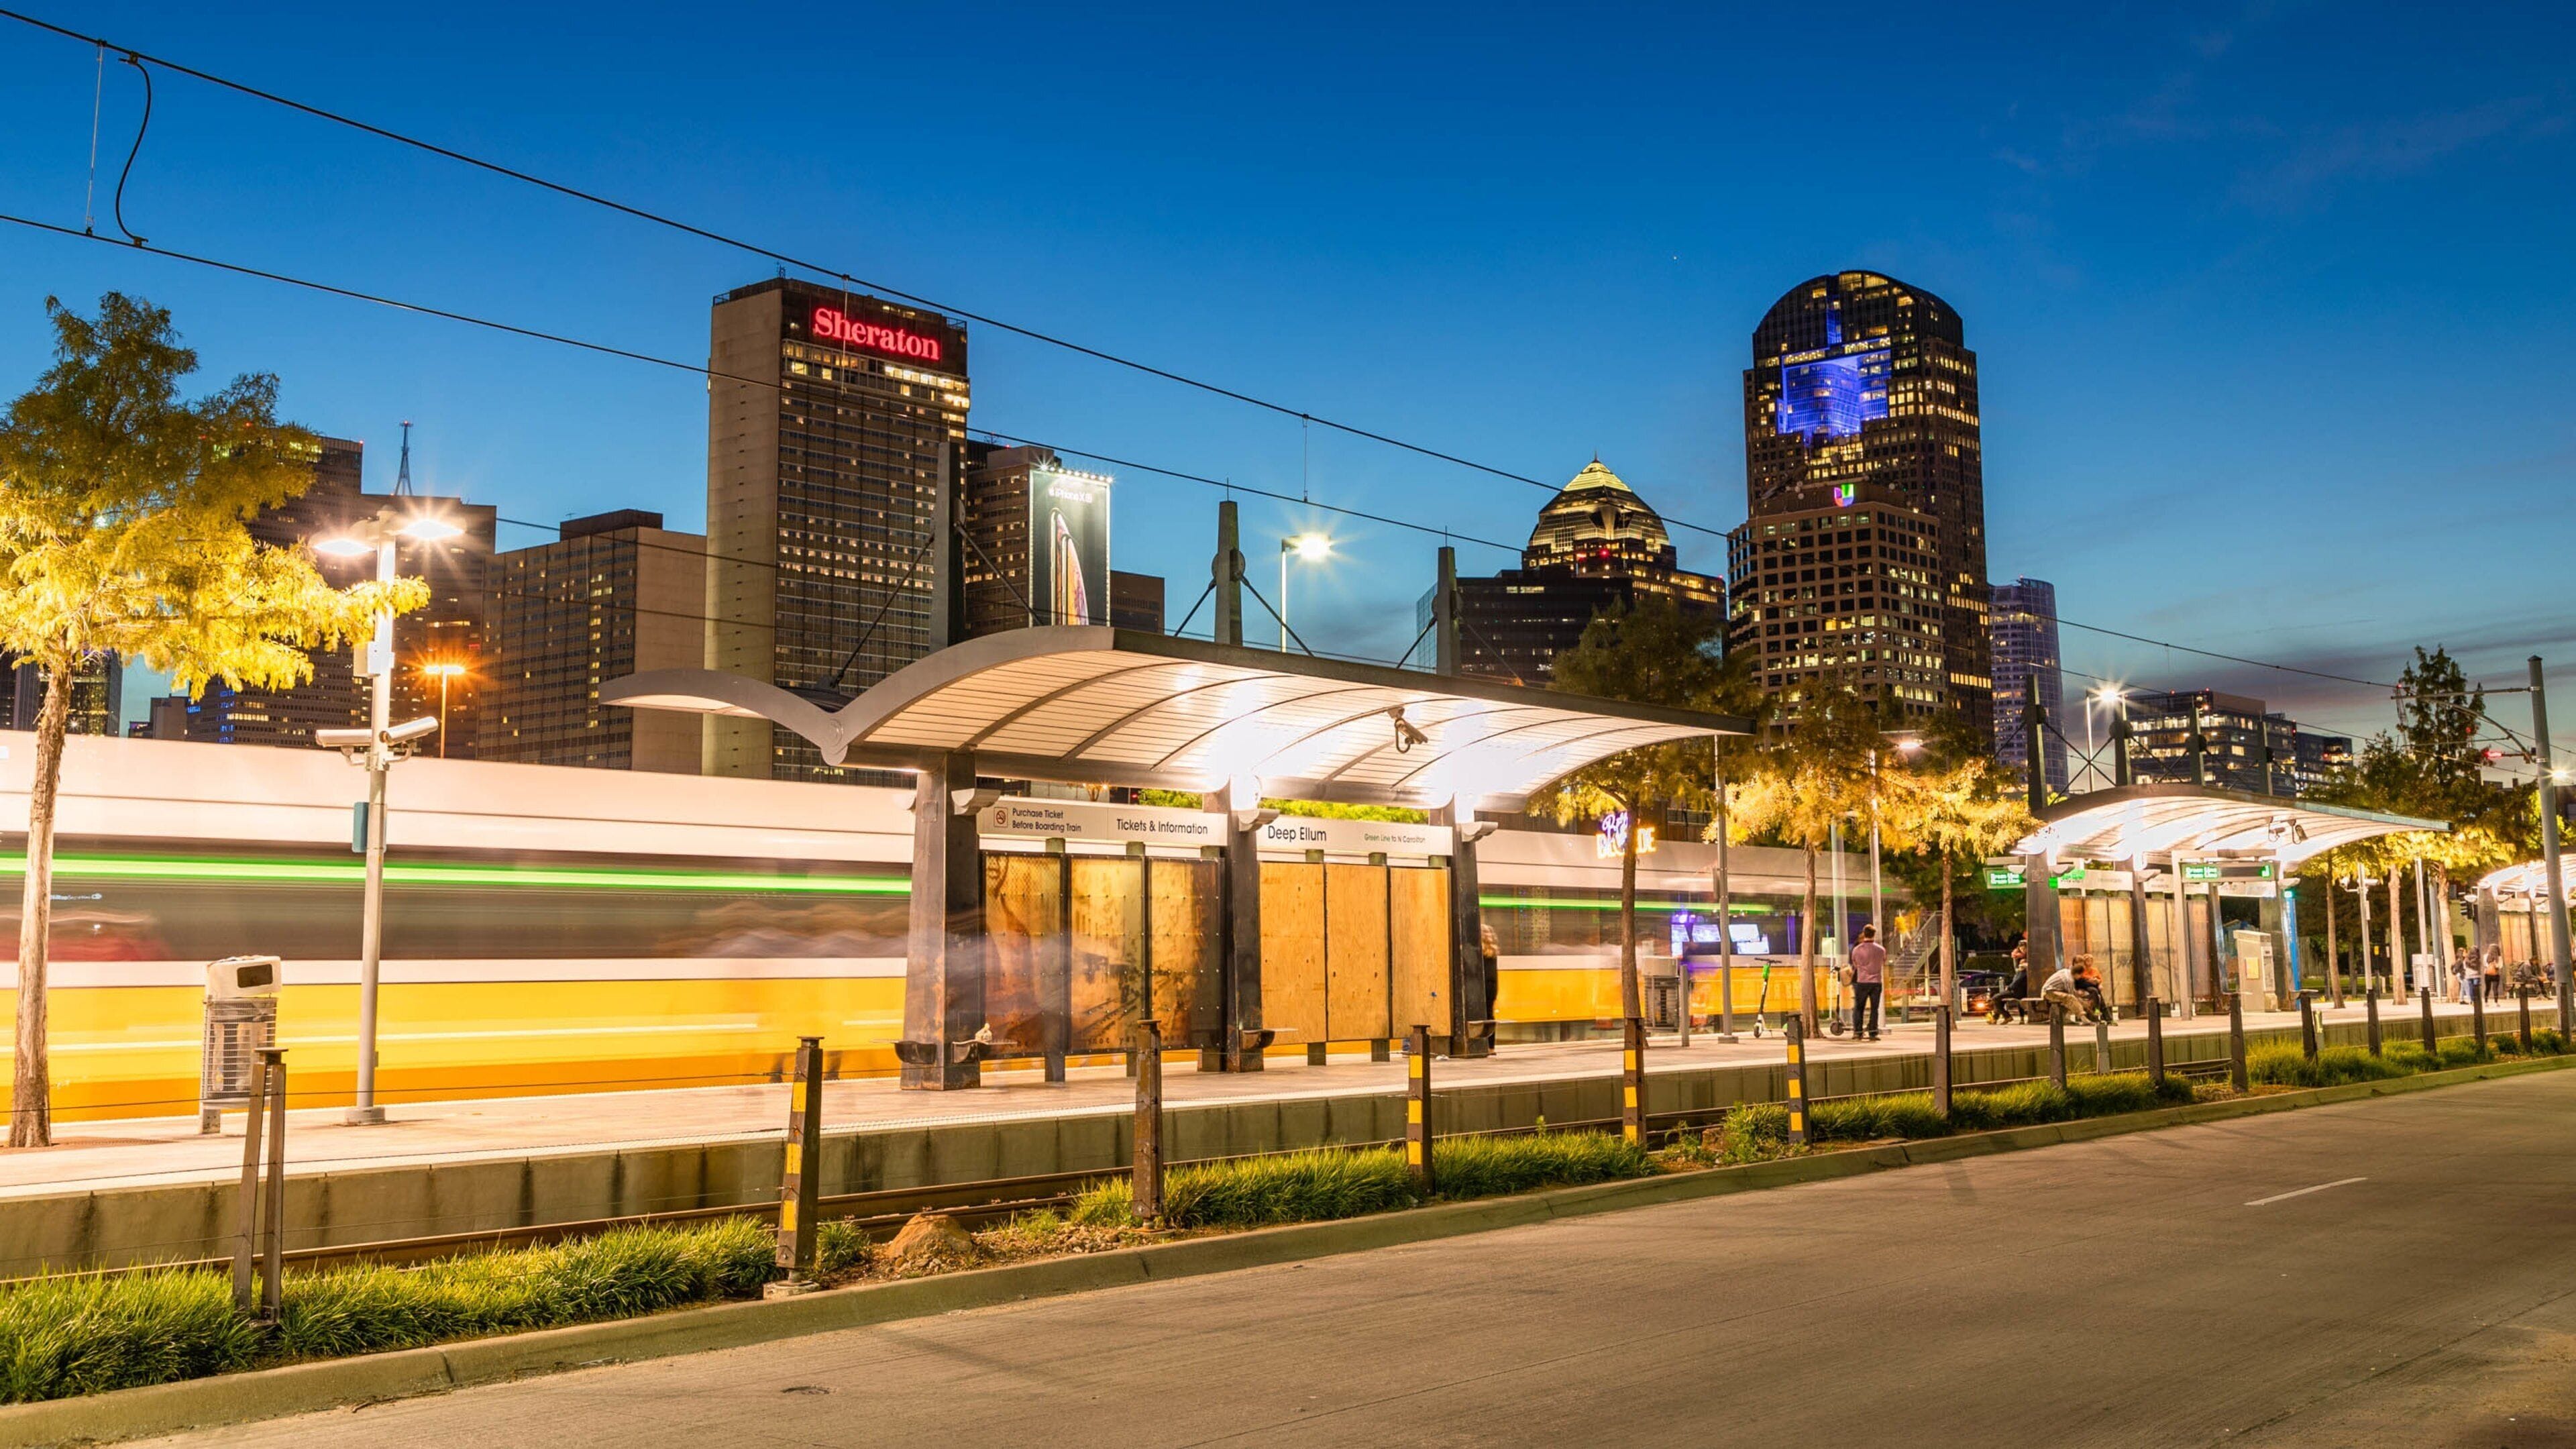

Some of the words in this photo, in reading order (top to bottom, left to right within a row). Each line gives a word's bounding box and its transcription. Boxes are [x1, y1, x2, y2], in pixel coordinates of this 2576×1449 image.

[814, 308, 940, 360] Sheraton
[1012, 808, 1043, 819] Purchase
[1044, 809, 1063, 819] Ticket
[1012, 820, 1034, 830] Before
[1035, 821, 1065, 833] Boarding
[1066, 822, 1081, 832] Train
[1117, 818, 1146, 832] Tickets
[1149, 820, 1156, 833] &
[1158, 820, 1208, 835] Information
[1268, 825, 1296, 842] Deep
[1299, 826, 1327, 842] Ellum
